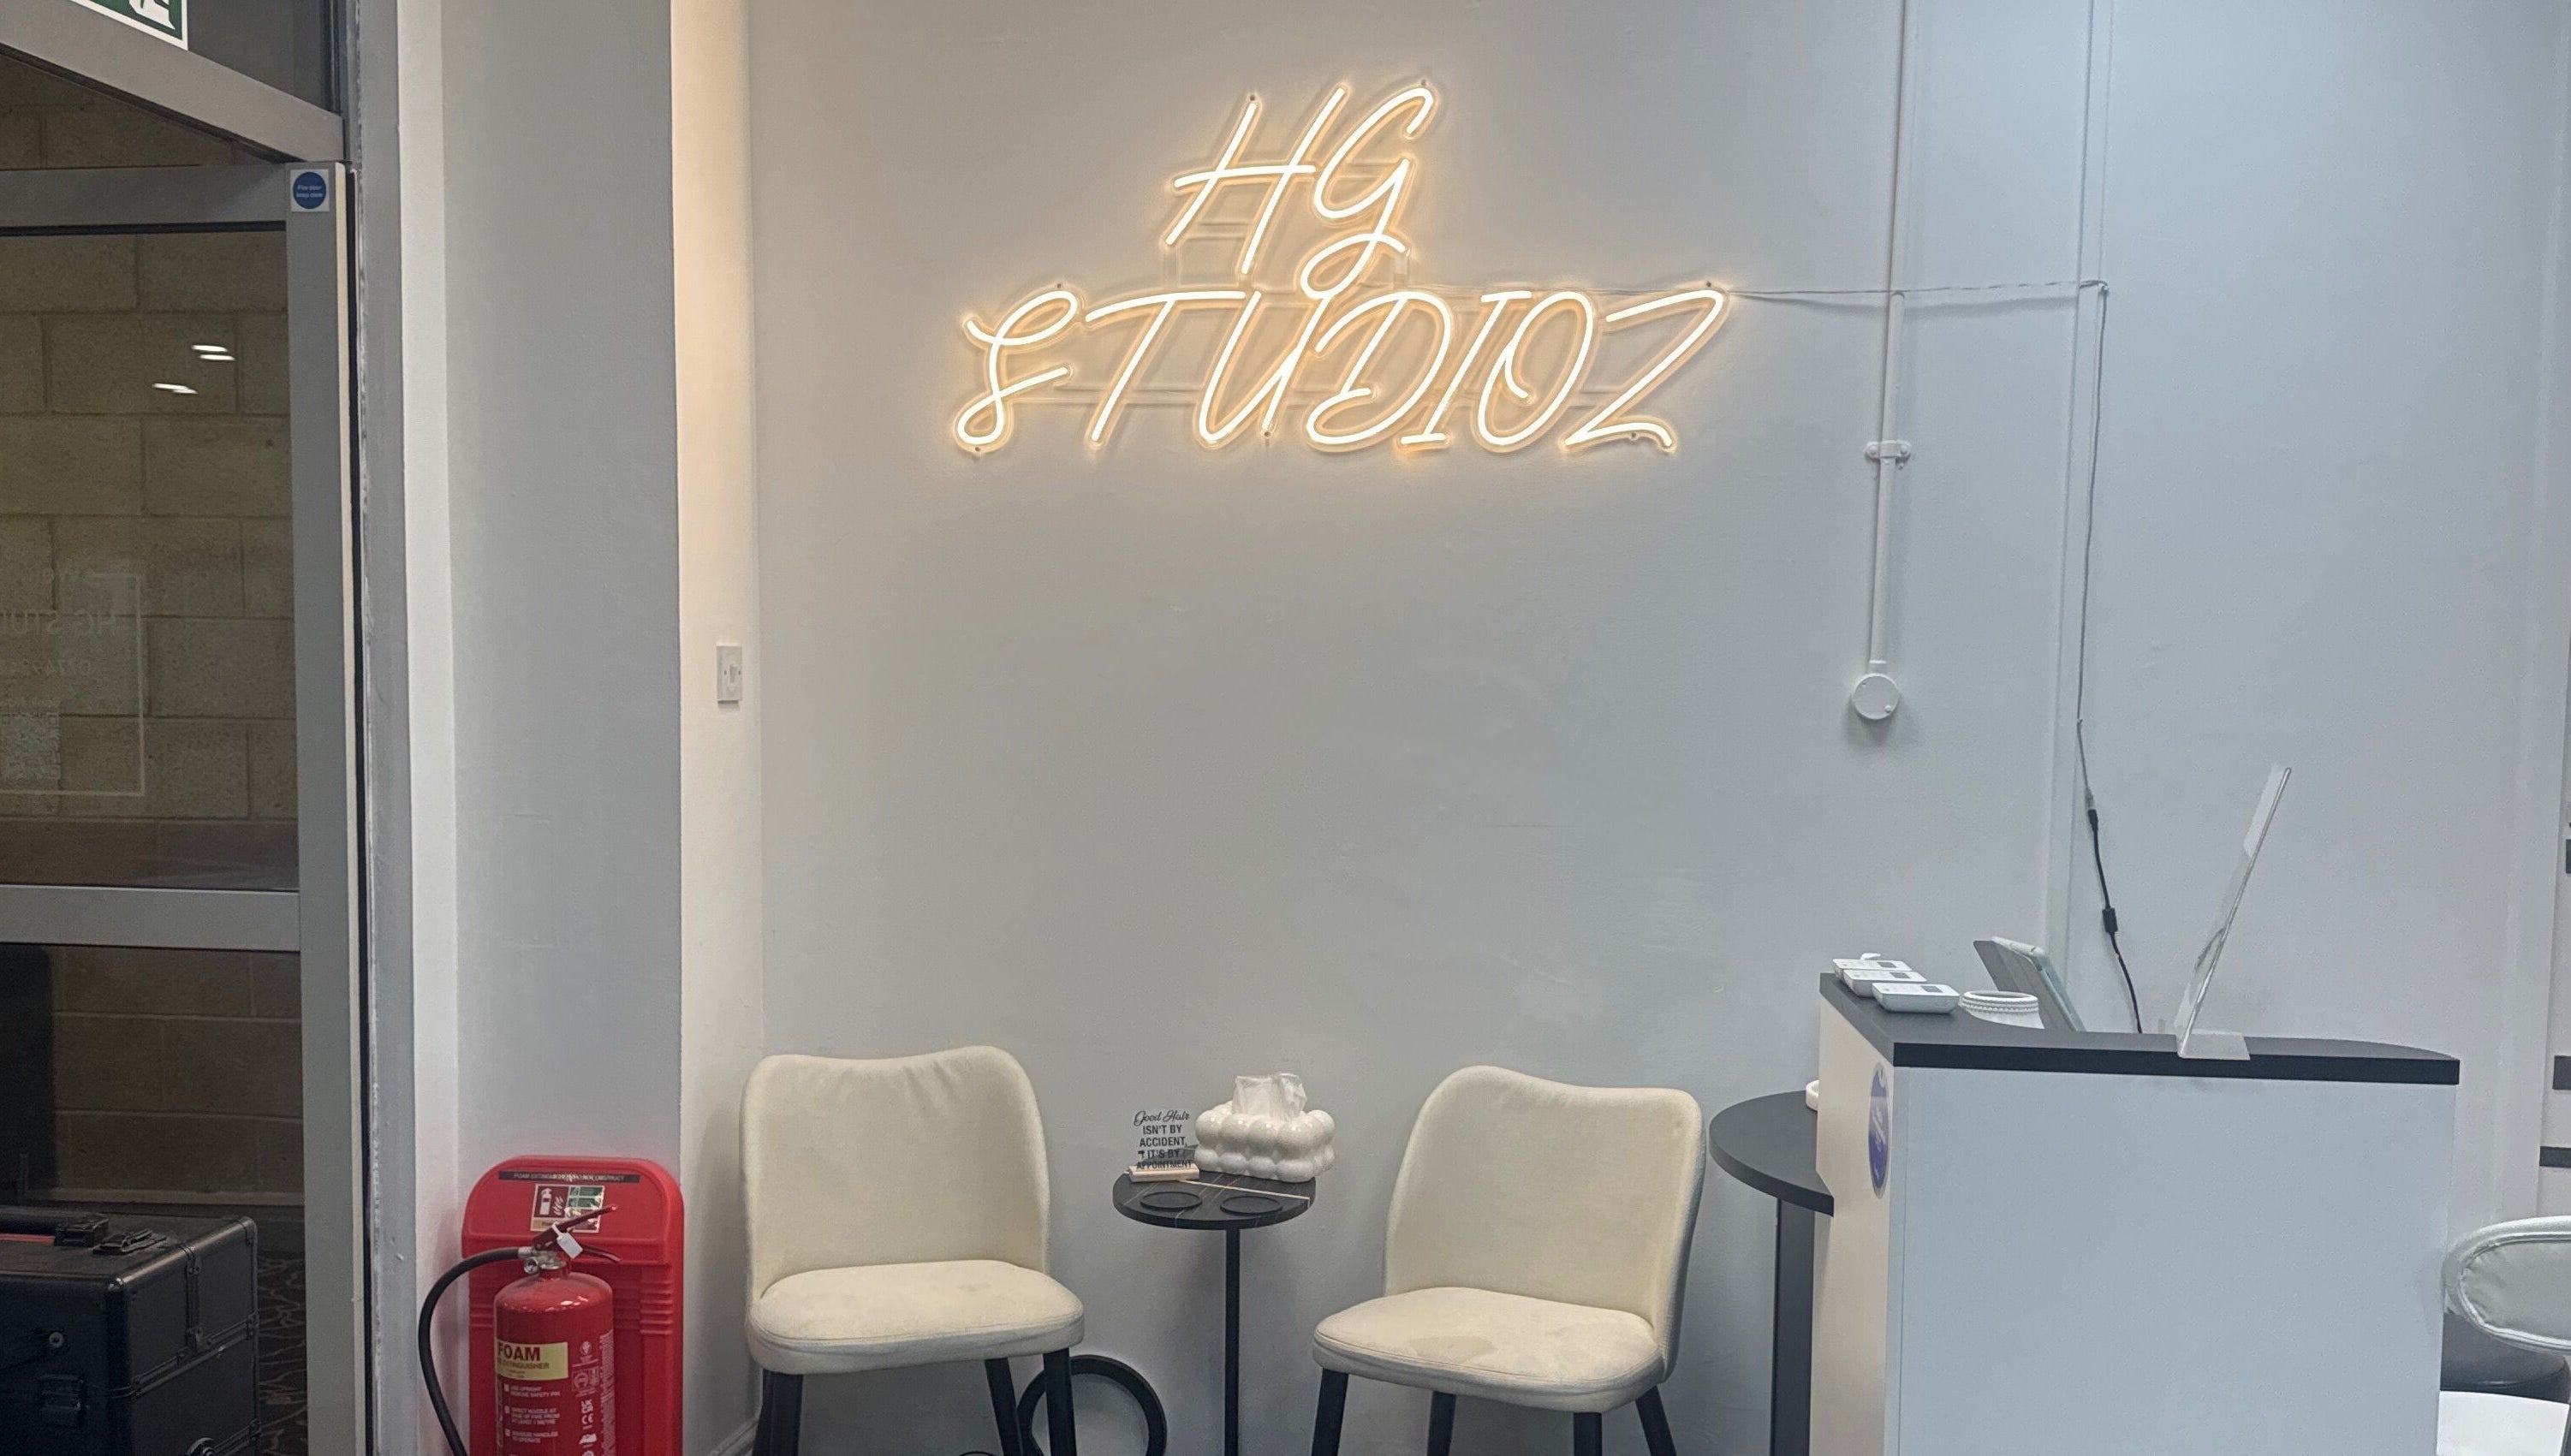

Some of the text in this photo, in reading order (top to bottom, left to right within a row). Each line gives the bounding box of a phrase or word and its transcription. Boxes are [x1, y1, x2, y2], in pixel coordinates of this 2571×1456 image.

[1164, 86, 1435, 299] HG
[955, 289, 1726, 447] STUDIOZ
[1134, 1109, 1190, 1126] Good Hair
[1143, 1125, 1182, 1135] ISN'T BY
[1139, 1137, 1187, 1147] ACCIDENT,
[1147, 1149, 1180, 1159] IT'S BY
[1136, 1159, 1193, 1170] APPOINTMENT
[497, 1340, 540, 1362] FOAM
